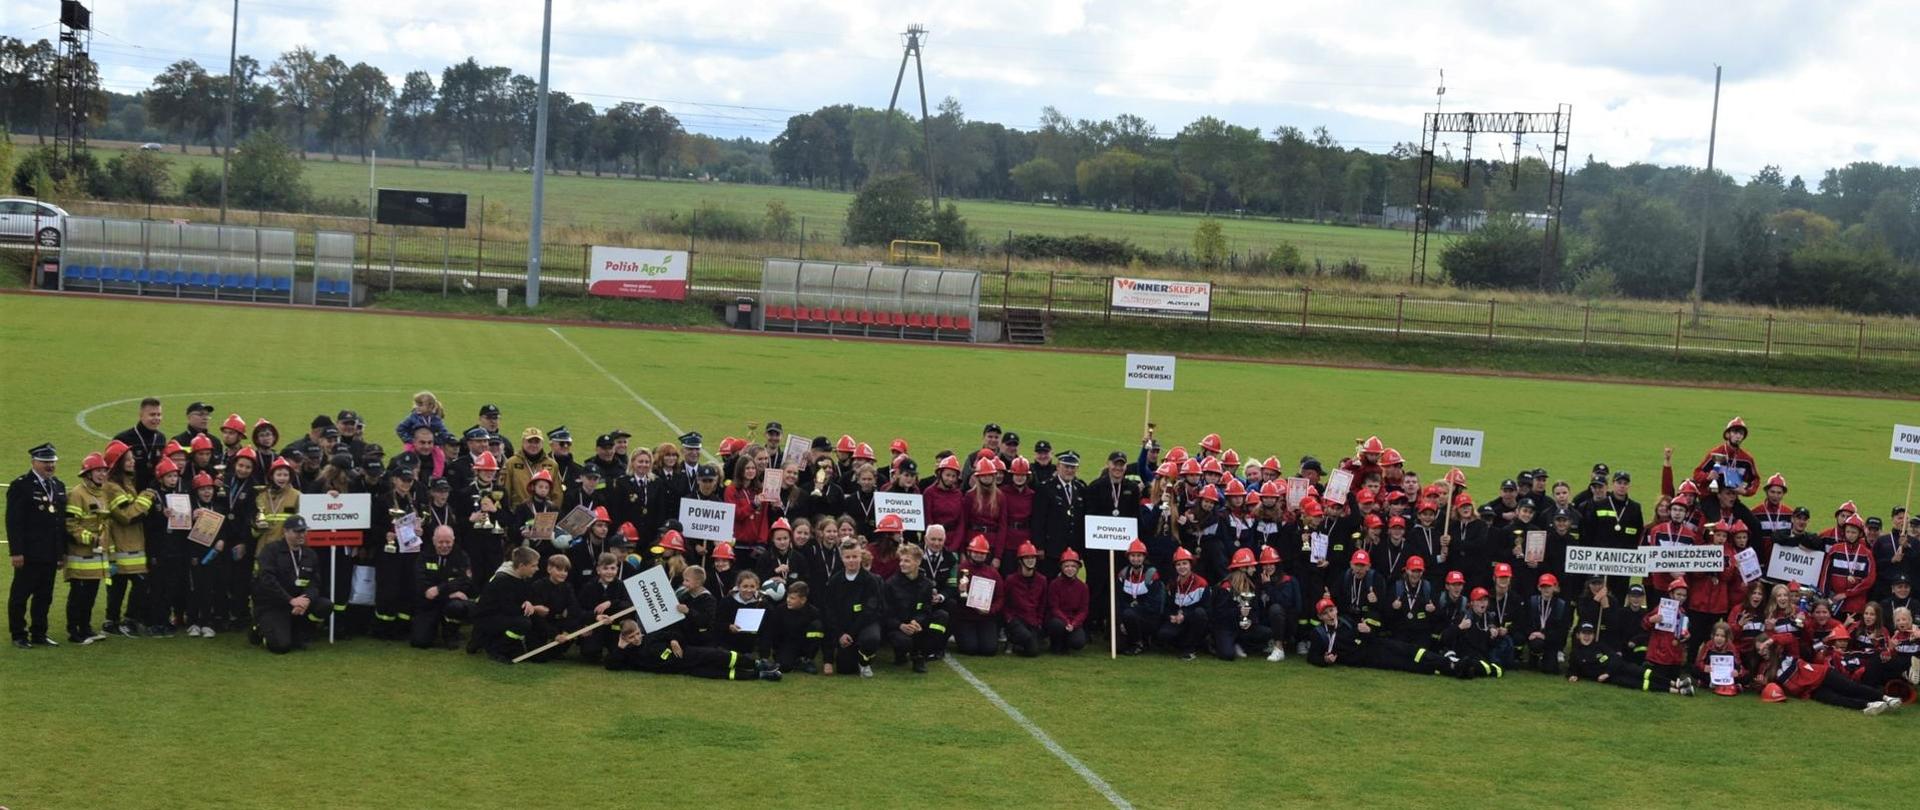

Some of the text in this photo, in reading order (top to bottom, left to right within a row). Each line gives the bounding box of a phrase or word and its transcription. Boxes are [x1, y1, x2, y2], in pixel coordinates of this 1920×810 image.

[604, 261, 668, 276] Polish Agro
[1117, 279, 1208, 295] WINNERSKLEP.PL
[1128, 371, 1171, 380] KOŚCIERSKI
[1439, 434, 1476, 446] POWIAT
[1440, 449, 1471, 458] LĘBORSKI
[327, 503, 344, 511] MDP
[885, 498, 913, 506] POWIAT
[312, 512, 359, 521] CZĘSTKOWO
[688, 506, 728, 521] POWIAT
[878, 507, 922, 515] STAROGARD
[691, 522, 721, 533] SŁUPSKI
[1092, 533, 1131, 541] KARTUSKI
[1569, 549, 1647, 565] OSP KANICZKI
[1778, 550, 1816, 567] POWIAT
[1568, 562, 1647, 575] POWIAT KWIDZYŃSKI
[1655, 561, 1723, 569] POWIAT PUCKI
[1783, 566, 1804, 577] PUCKI
[638, 580, 661, 623] CHOJNICKI
[650, 581, 668, 612] POWIAT
